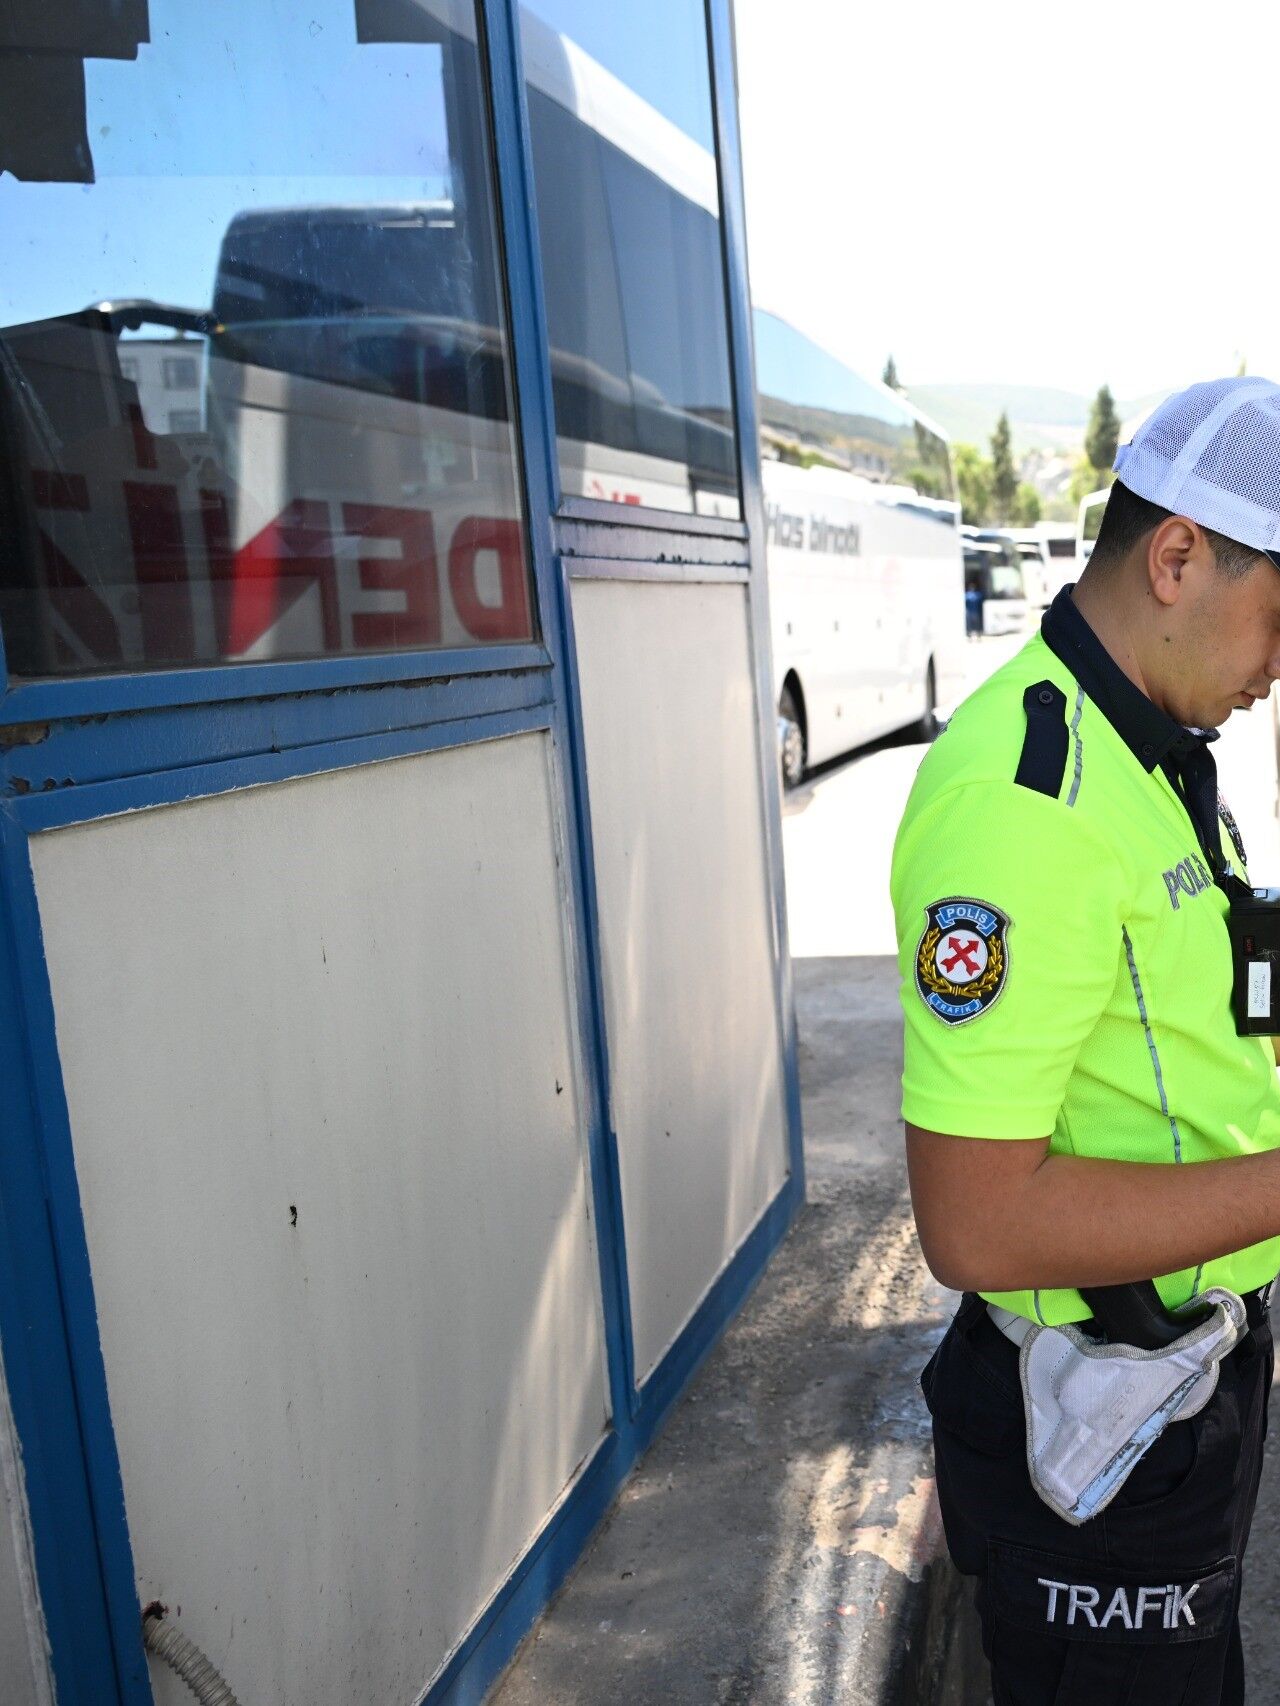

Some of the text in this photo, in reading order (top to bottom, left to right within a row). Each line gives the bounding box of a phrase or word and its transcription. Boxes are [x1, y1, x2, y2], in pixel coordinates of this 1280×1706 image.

[1162, 850, 1213, 911] POLİ
[946, 907, 988, 924] POLİS
[935, 1000, 972, 1015] TRAFİK
[1037, 1577, 1200, 1629] TRAFİK
